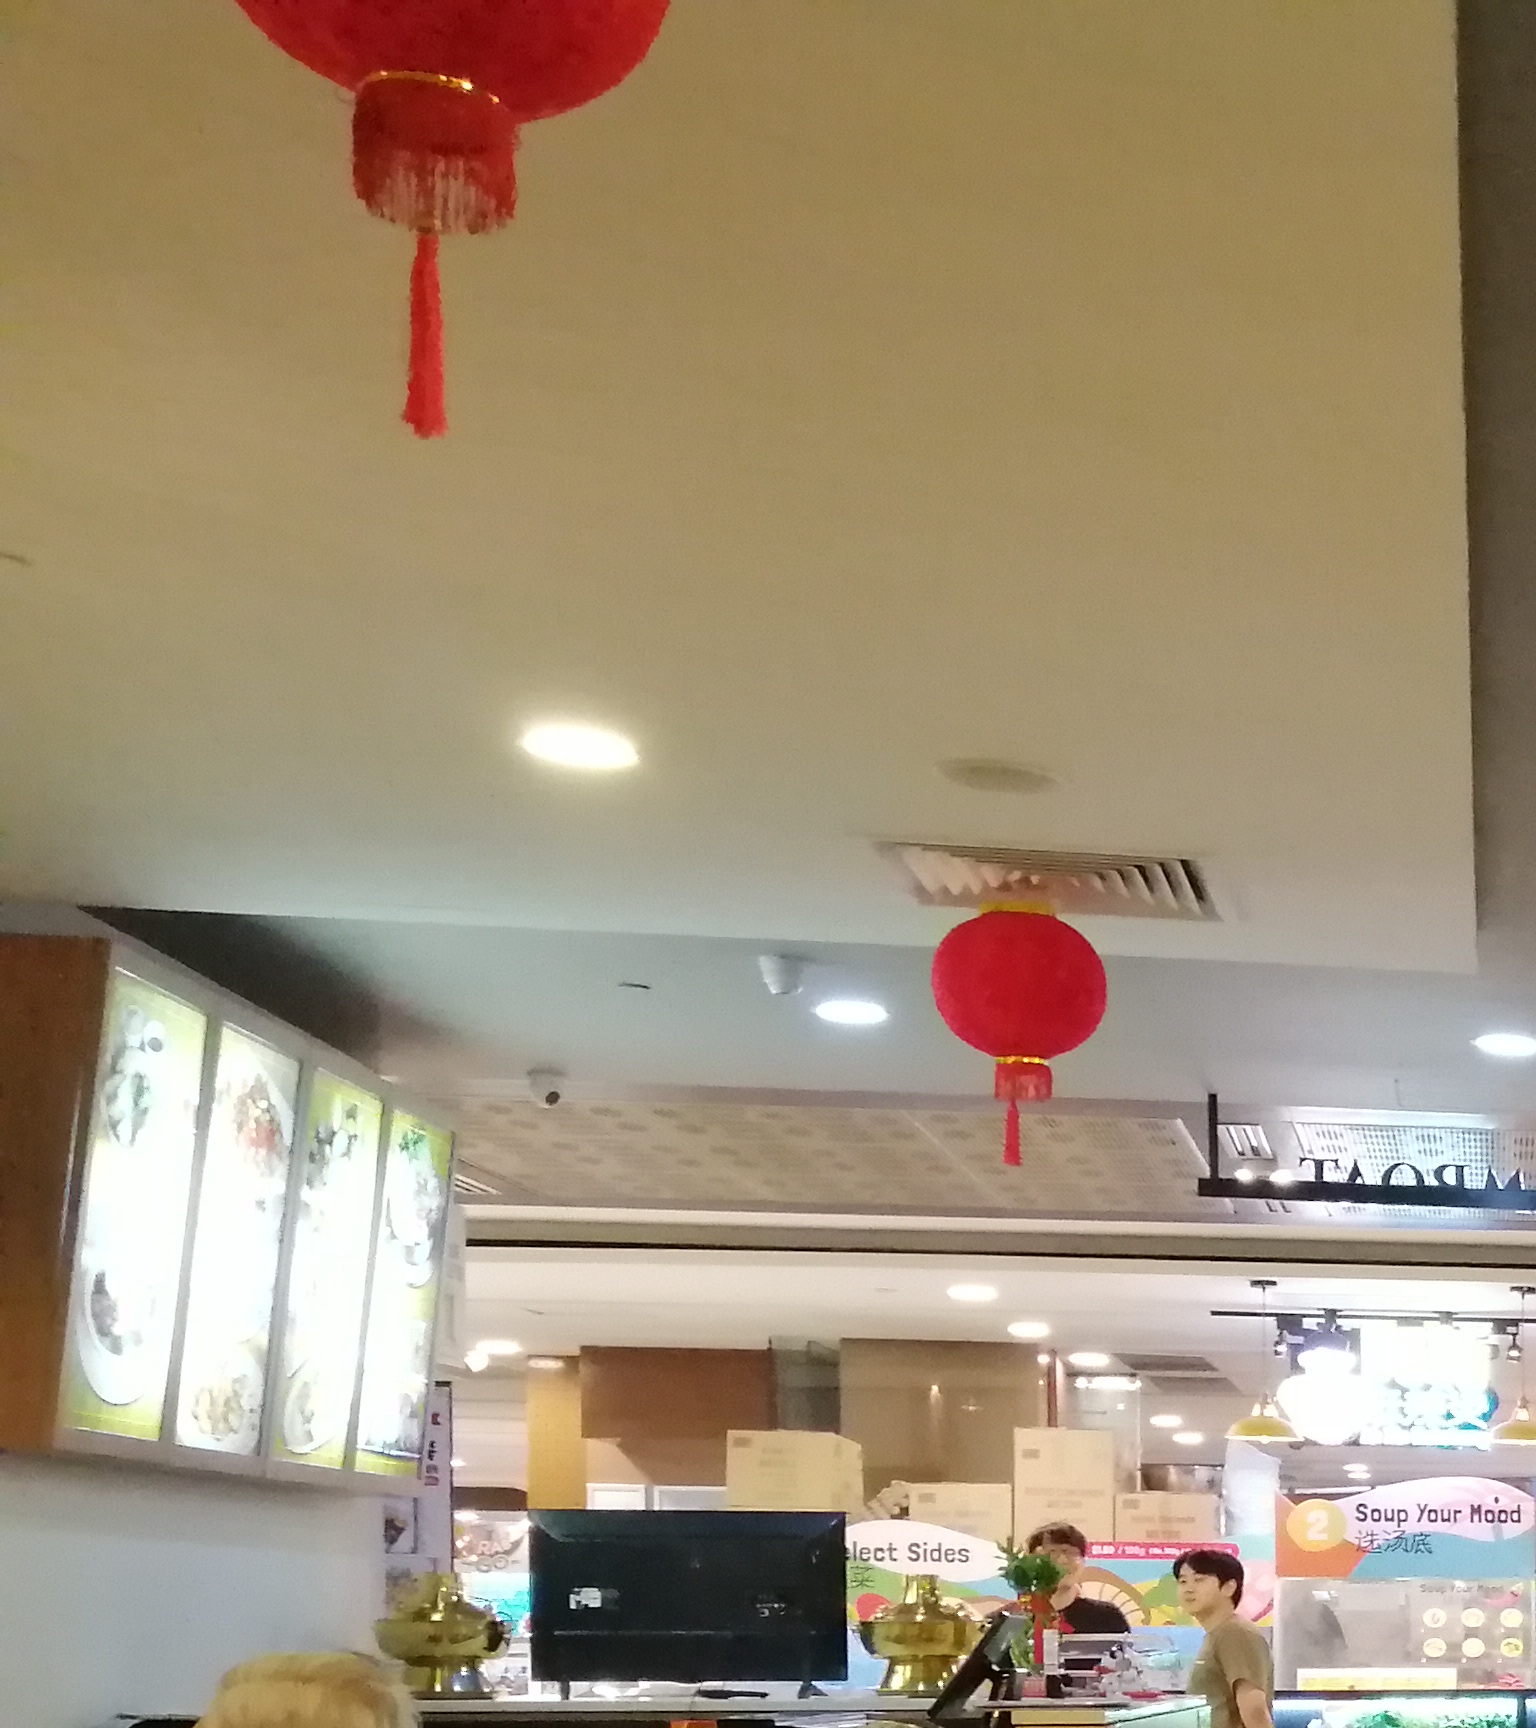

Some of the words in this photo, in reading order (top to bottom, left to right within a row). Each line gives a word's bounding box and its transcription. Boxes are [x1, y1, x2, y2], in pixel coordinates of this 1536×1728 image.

[1306, 1509, 1329, 1541] 2
[1355, 1503, 1409, 1528] Soup
[1416, 1503, 1463, 1523] Your
[1470, 1503, 1521, 1524] Mood
[907, 1542, 970, 1563] Sides
[1354, 1530, 1434, 1555] 选汤底
